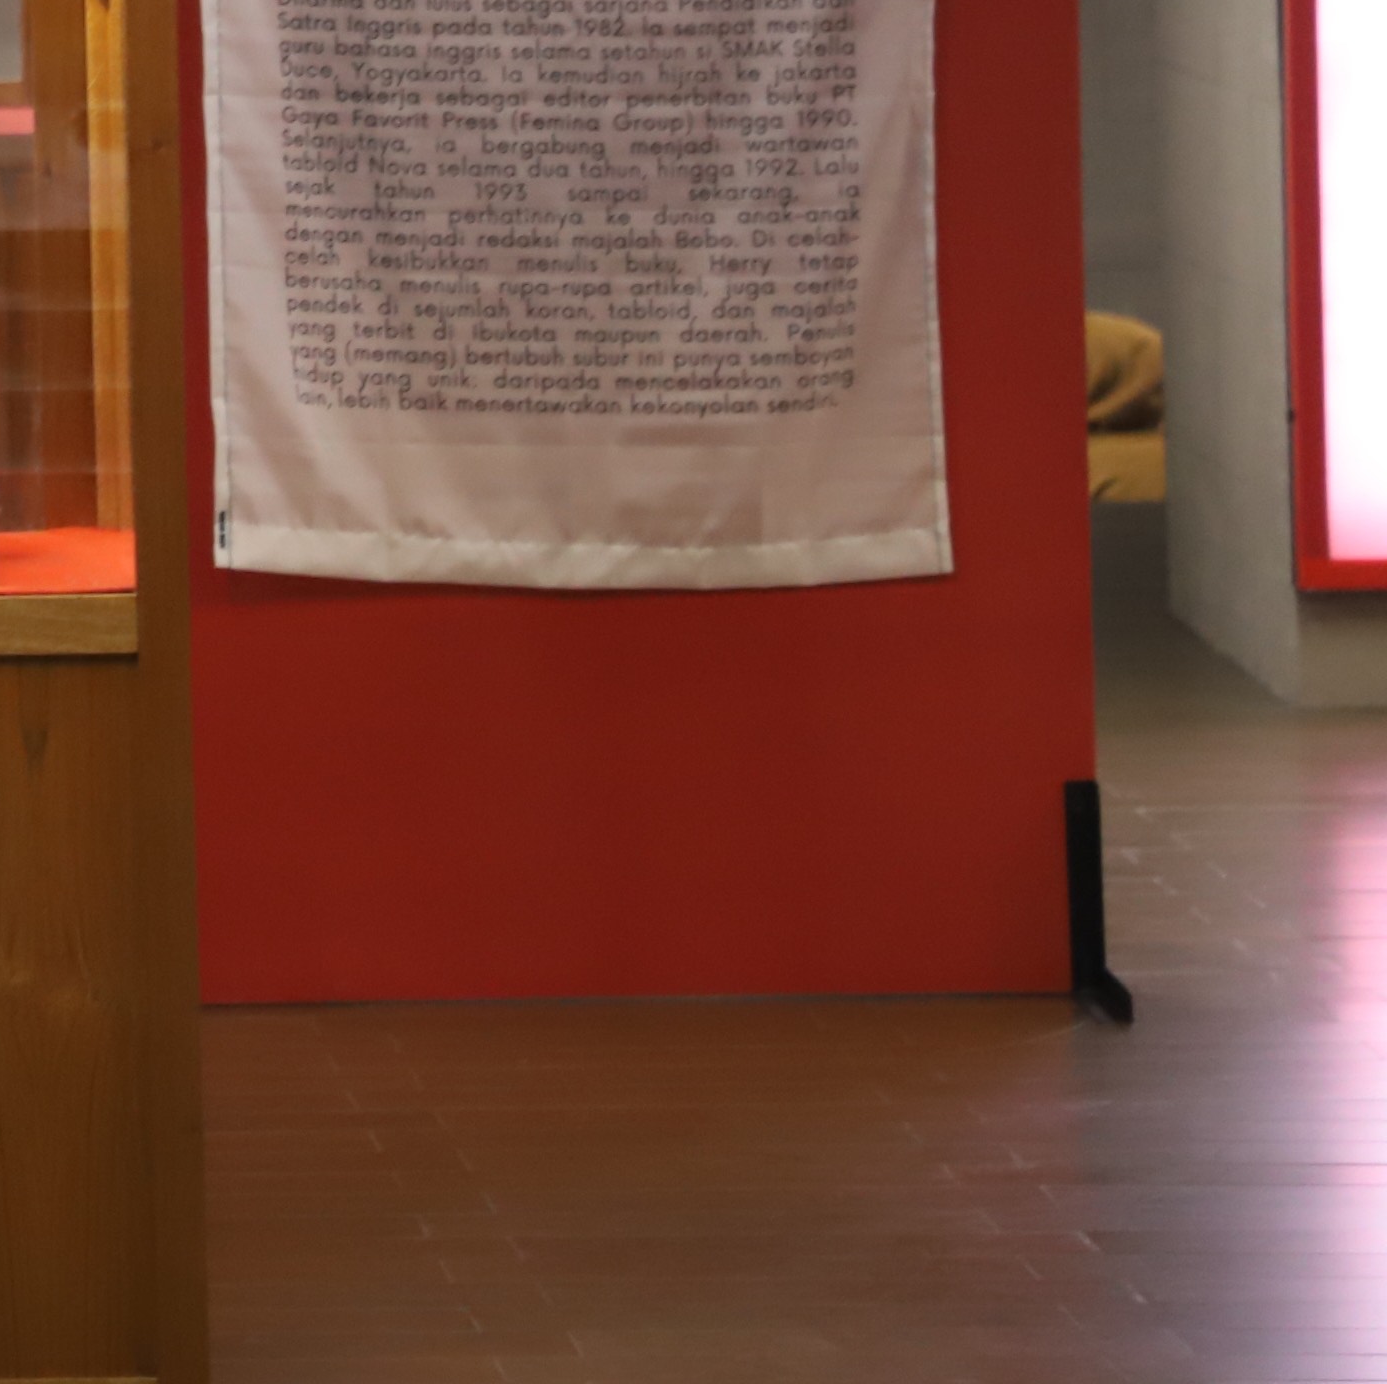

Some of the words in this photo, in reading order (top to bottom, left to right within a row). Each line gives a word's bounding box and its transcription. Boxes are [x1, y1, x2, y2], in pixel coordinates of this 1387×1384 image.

[277, 11, 336, 33] Satra
[431, 15, 492, 41] pada
[501, 15, 565, 37] tahun
[640, 18, 665, 39] Ia
[672, 17, 755, 44] sempat
[766, 12, 856, 40] menjadi
[278, 41, 325, 62] guru
[332, 37, 417, 61] bahasa
[426, 43, 501, 67] inggris
[510, 40, 591, 61] selama
[600, 40, 685, 62] setahun
[722, 38, 782, 60] SMAK
[794, 36, 856, 58] Stella
[502, 63, 523, 84] Ia
[537, 63, 642, 85] kemudian
[735, 62, 760, 83] ke
[278, 80, 321, 103] dan
[333, 82, 422, 111] bekerja
[434, 85, 527, 112] sebagai
[542, 86, 611, 107] editor
[623, 85, 751, 112] penerbitan
[765, 82, 819, 105] buku
[829, 79, 857, 102] PT
[280, 105, 339, 133] Gaya
[351, 107, 429, 129] Favorit
[440, 109, 498, 131] Press
[510, 110, 601, 138] (Femina
[612, 110, 693, 138] Group)
[704, 108, 783, 136] hingga
[797, 106, 857, 128] 1990.
[435, 137, 456, 156] ia
[480, 135, 606, 162] bergabung
[629, 135, 721, 161] menjadi
[745, 134, 858, 155] wartawan
[281, 149, 359, 173] tabloid
[367, 153, 427, 177] Nova
[436, 156, 517, 179] selama
[527, 158, 569, 180] dua
[656, 158, 735, 184] hingga
[812, 157, 860, 179] Lalu
[285, 175, 334, 202] sejak
[373, 178, 435, 201] tahun
[476, 180, 528, 202] 1993
[567, 186, 647, 209] sampai
[688, 181, 799, 208] sekarang,
[839, 183, 861, 201] ia
[605, 206, 630, 227] ke
[653, 205, 716, 226] dunia
[736, 202, 861, 226] anak-anak
[283, 222, 363, 250] dengan
[375, 225, 464, 254] menjadi
[476, 228, 559, 250] redaksi
[571, 229, 662, 256] majalah
[673, 229, 739, 251] Bobo.
[751, 228, 775, 250] Di
[283, 243, 339, 267] celah
[367, 248, 489, 272] kesibukkan
[623, 254, 682, 278] buku,
[709, 251, 772, 278] Herry
[798, 253, 858, 276] tetap
[283, 267, 382, 293] berusaha
[498, 283, 612, 303] rupa-rupa
[793, 276, 857, 296] cerita
[286, 293, 363, 321] pendek
[379, 296, 399, 318] di
[414, 297, 508, 324] sejumlah
[713, 298, 753, 319] dan
[771, 296, 854, 324] majalah
[288, 321, 336, 343] yang
[353, 318, 414, 340] terbit
[432, 320, 453, 342] di
[574, 328, 660, 349] maupun
[679, 321, 768, 344] daerah.
[290, 346, 336, 367] yang
[344, 341, 456, 371] (memang)
[464, 345, 563, 368] bertubuh
[572, 346, 628, 368] subur
[638, 349, 663, 367] ini
[672, 352, 740, 372] punya
[749, 341, 854, 372] semboyan
[358, 372, 412, 393] yang
[492, 369, 600, 396] daripada
[614, 368, 781, 391] mencelakakan
[337, 389, 390, 411] lebih
[397, 391, 448, 413] baik
[454, 392, 622, 416] menertawakan
[629, 394, 759, 422] kekonyolan
